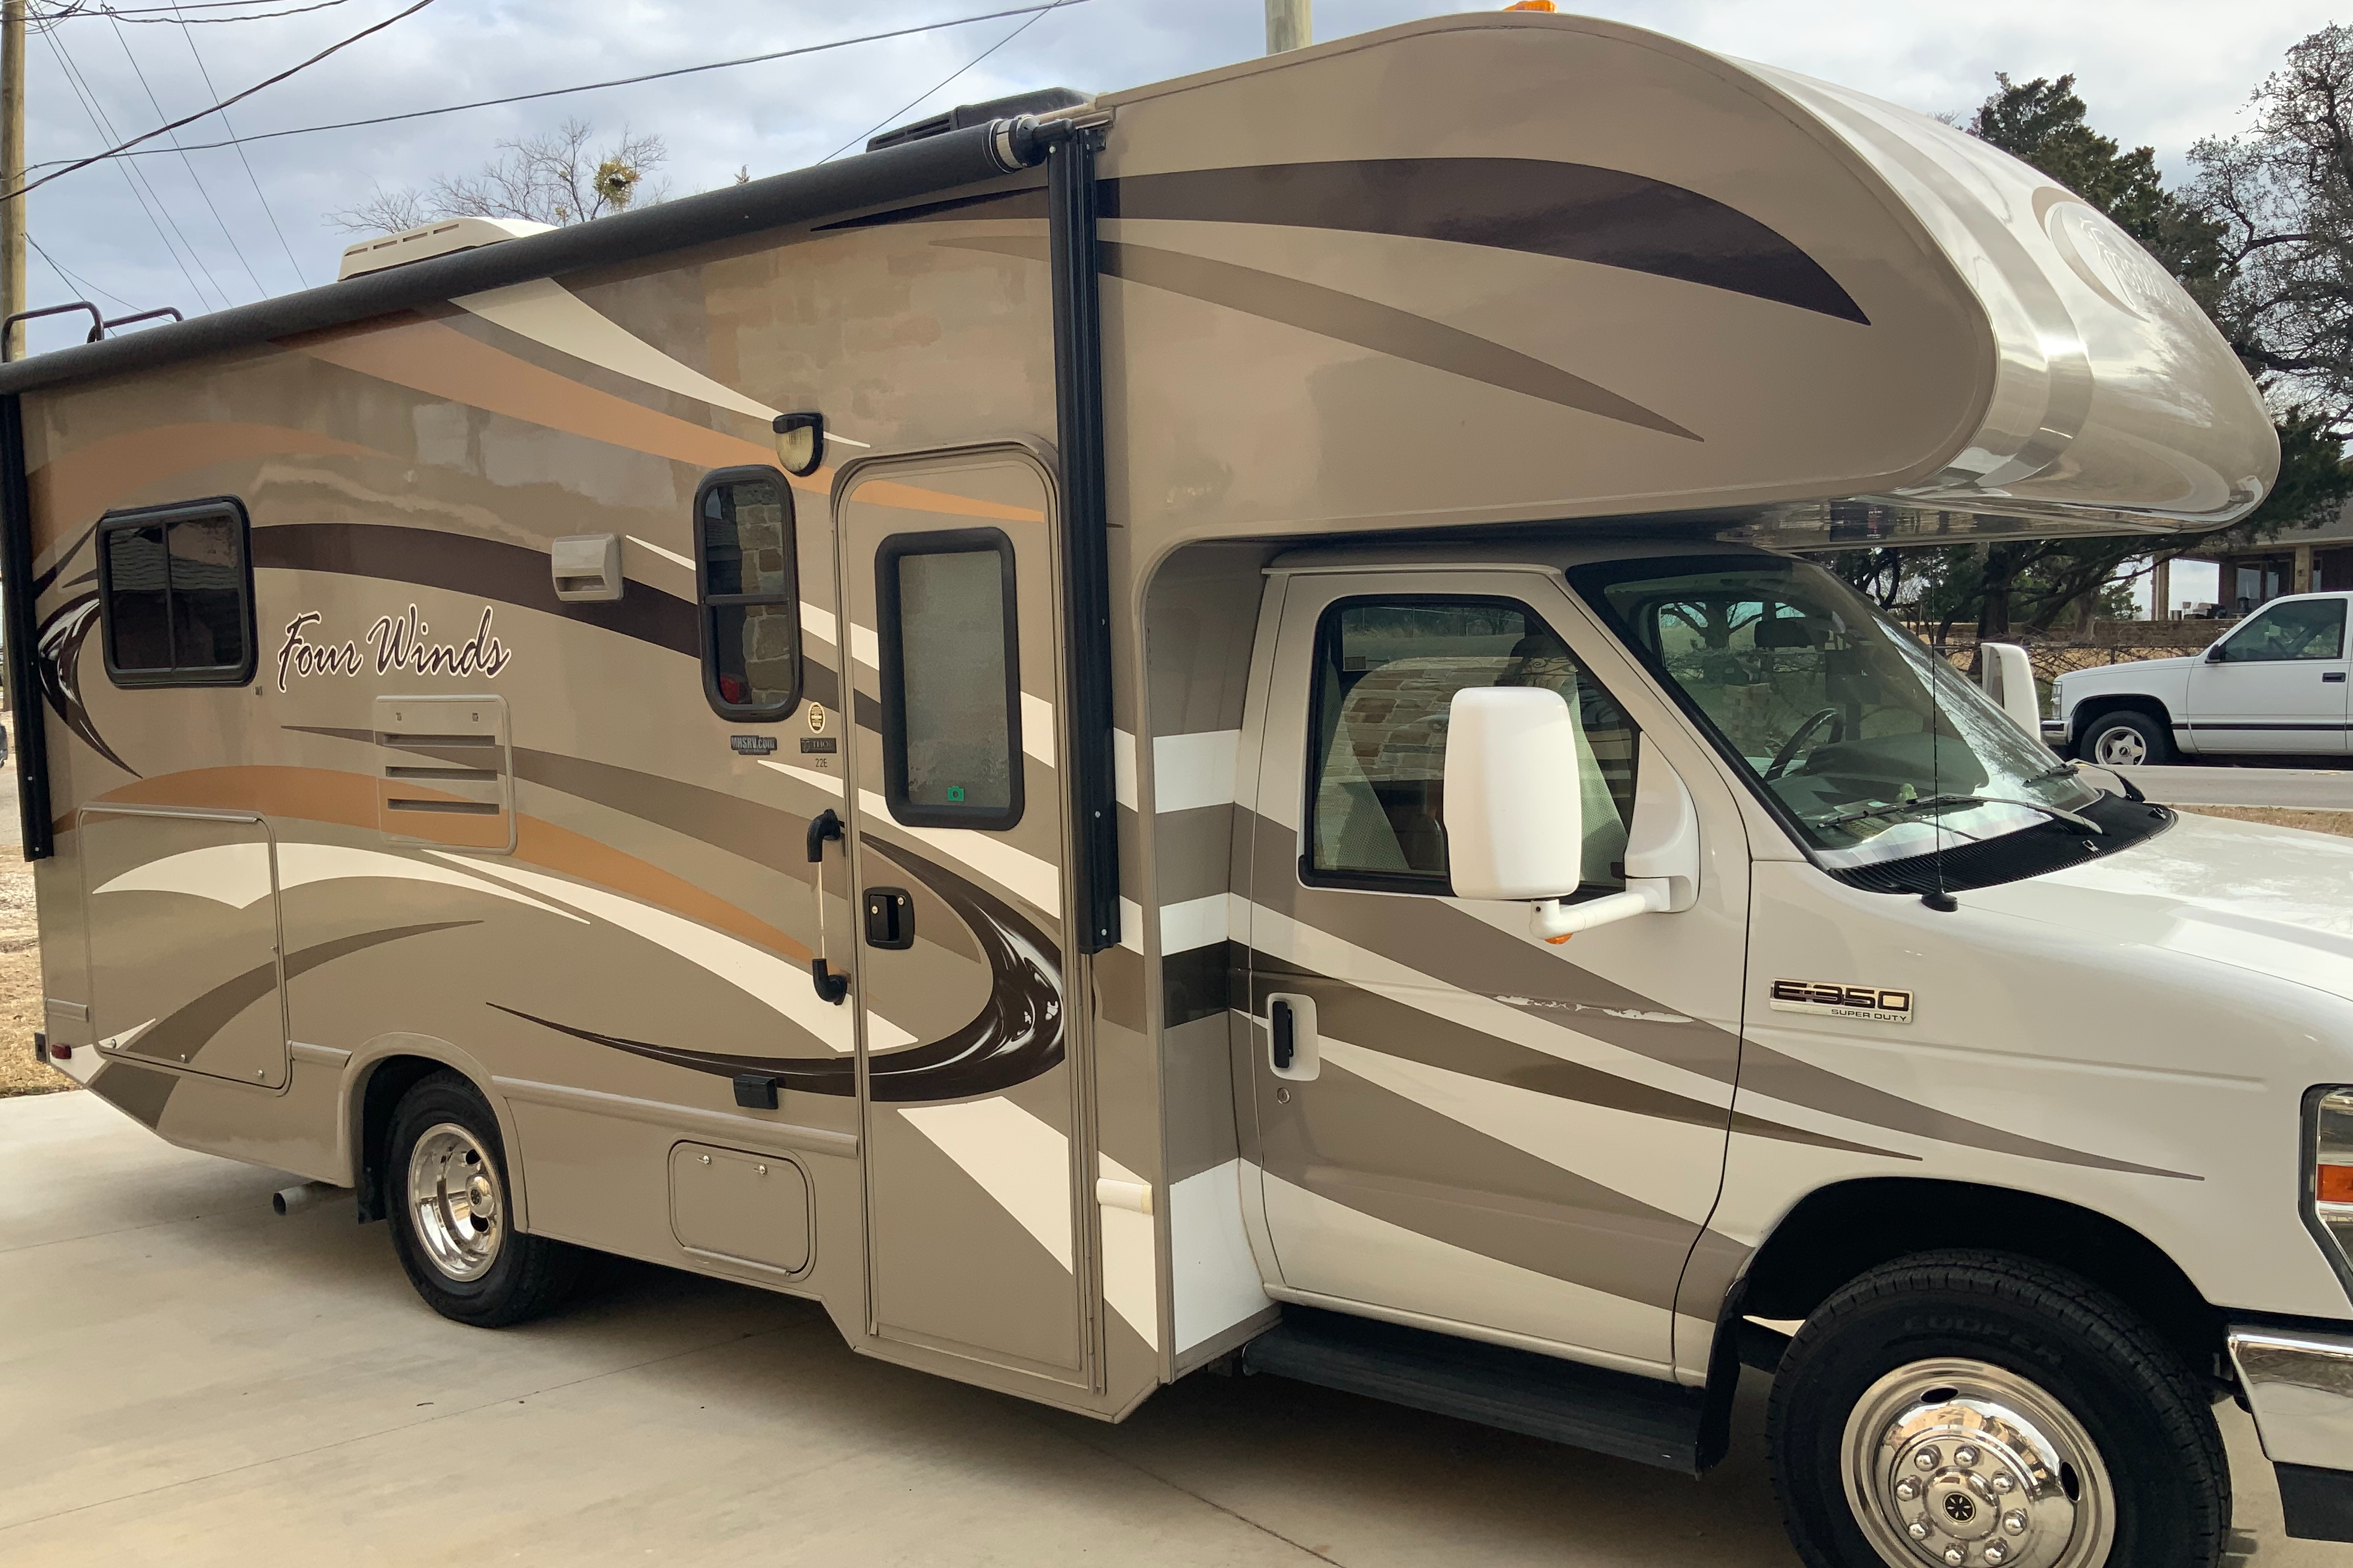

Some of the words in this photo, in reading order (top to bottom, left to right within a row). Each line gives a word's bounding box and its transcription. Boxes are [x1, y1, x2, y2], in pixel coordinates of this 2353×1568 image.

[277, 610, 364, 693] Four
[366, 603, 512, 679] Winds
[815, 758, 828, 768] 22E
[1831, 1009, 1870, 1018] SUPER
[1874, 1013, 1907, 1022] DUTY
